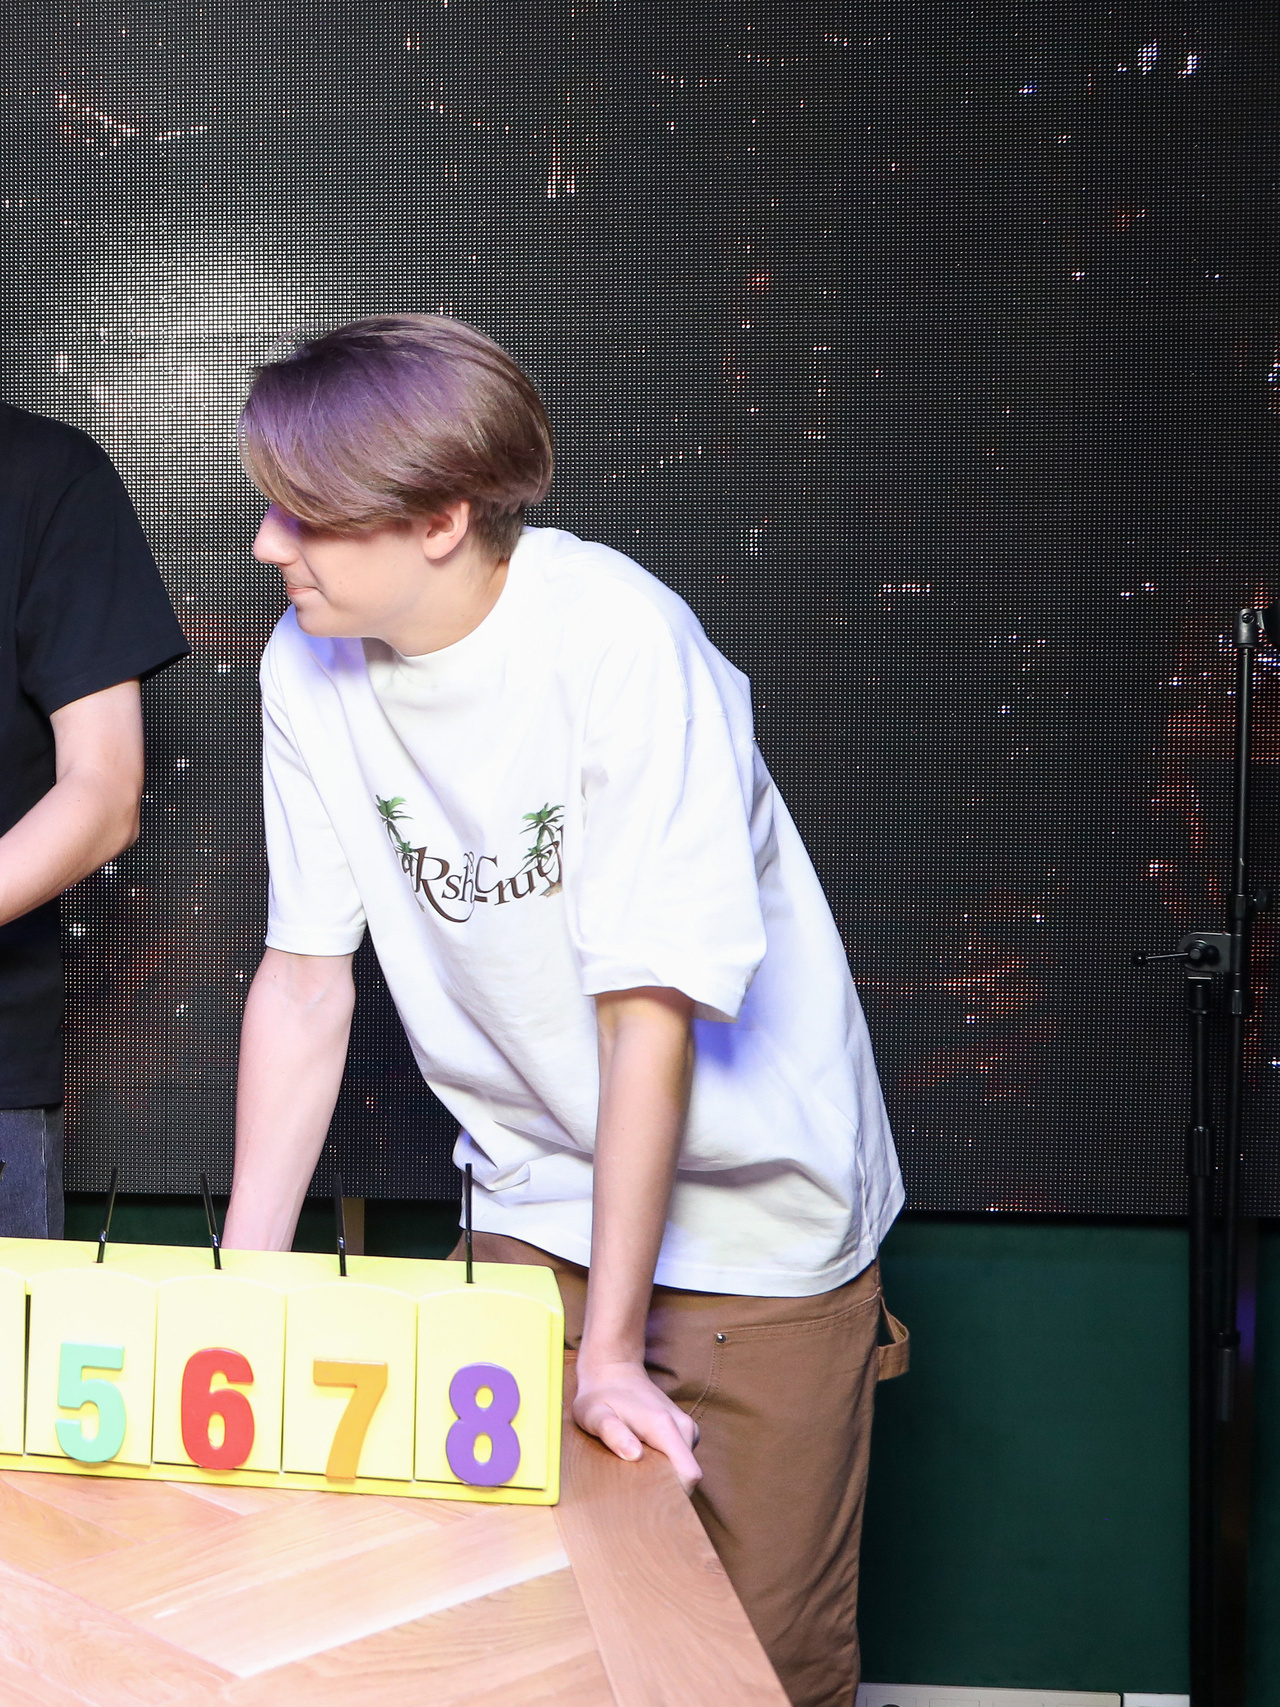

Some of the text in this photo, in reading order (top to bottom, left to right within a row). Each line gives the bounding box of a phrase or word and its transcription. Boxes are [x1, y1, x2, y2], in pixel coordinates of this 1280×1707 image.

[55, 1341, 126, 1463] 5
[181, 1346, 255, 1470] 6
[313, 1357, 389, 1480] 7
[446, 1361, 520, 1486] 8
